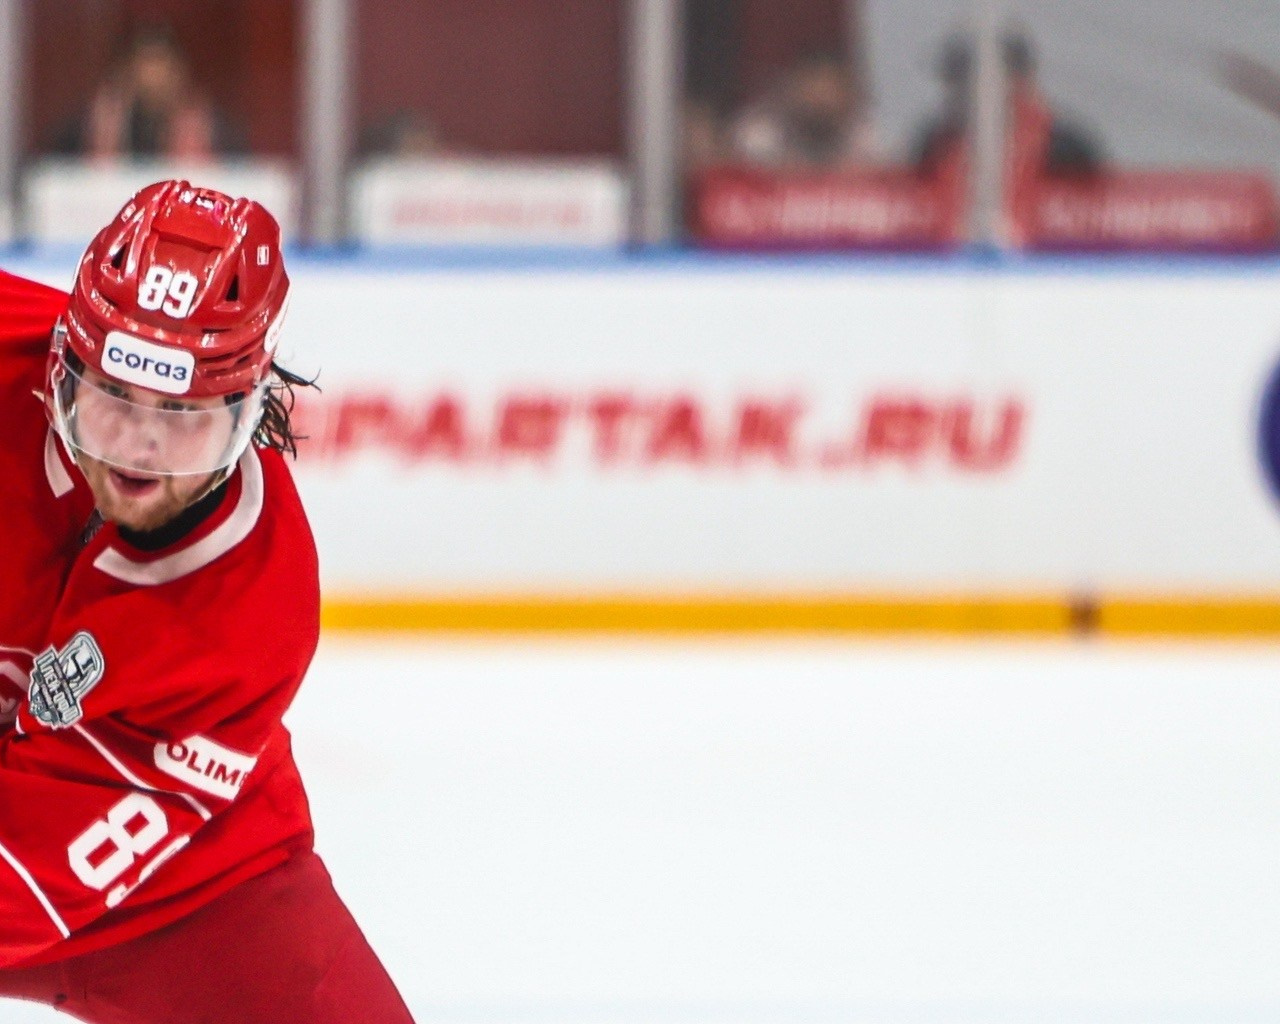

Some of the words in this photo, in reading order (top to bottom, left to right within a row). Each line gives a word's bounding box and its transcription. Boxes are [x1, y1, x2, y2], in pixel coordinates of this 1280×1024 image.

[137, 266, 199, 319] 89
[108, 347, 187, 381] согаз
[166, 742, 247, 788] OLIM
[67, 792, 191, 909] 8
